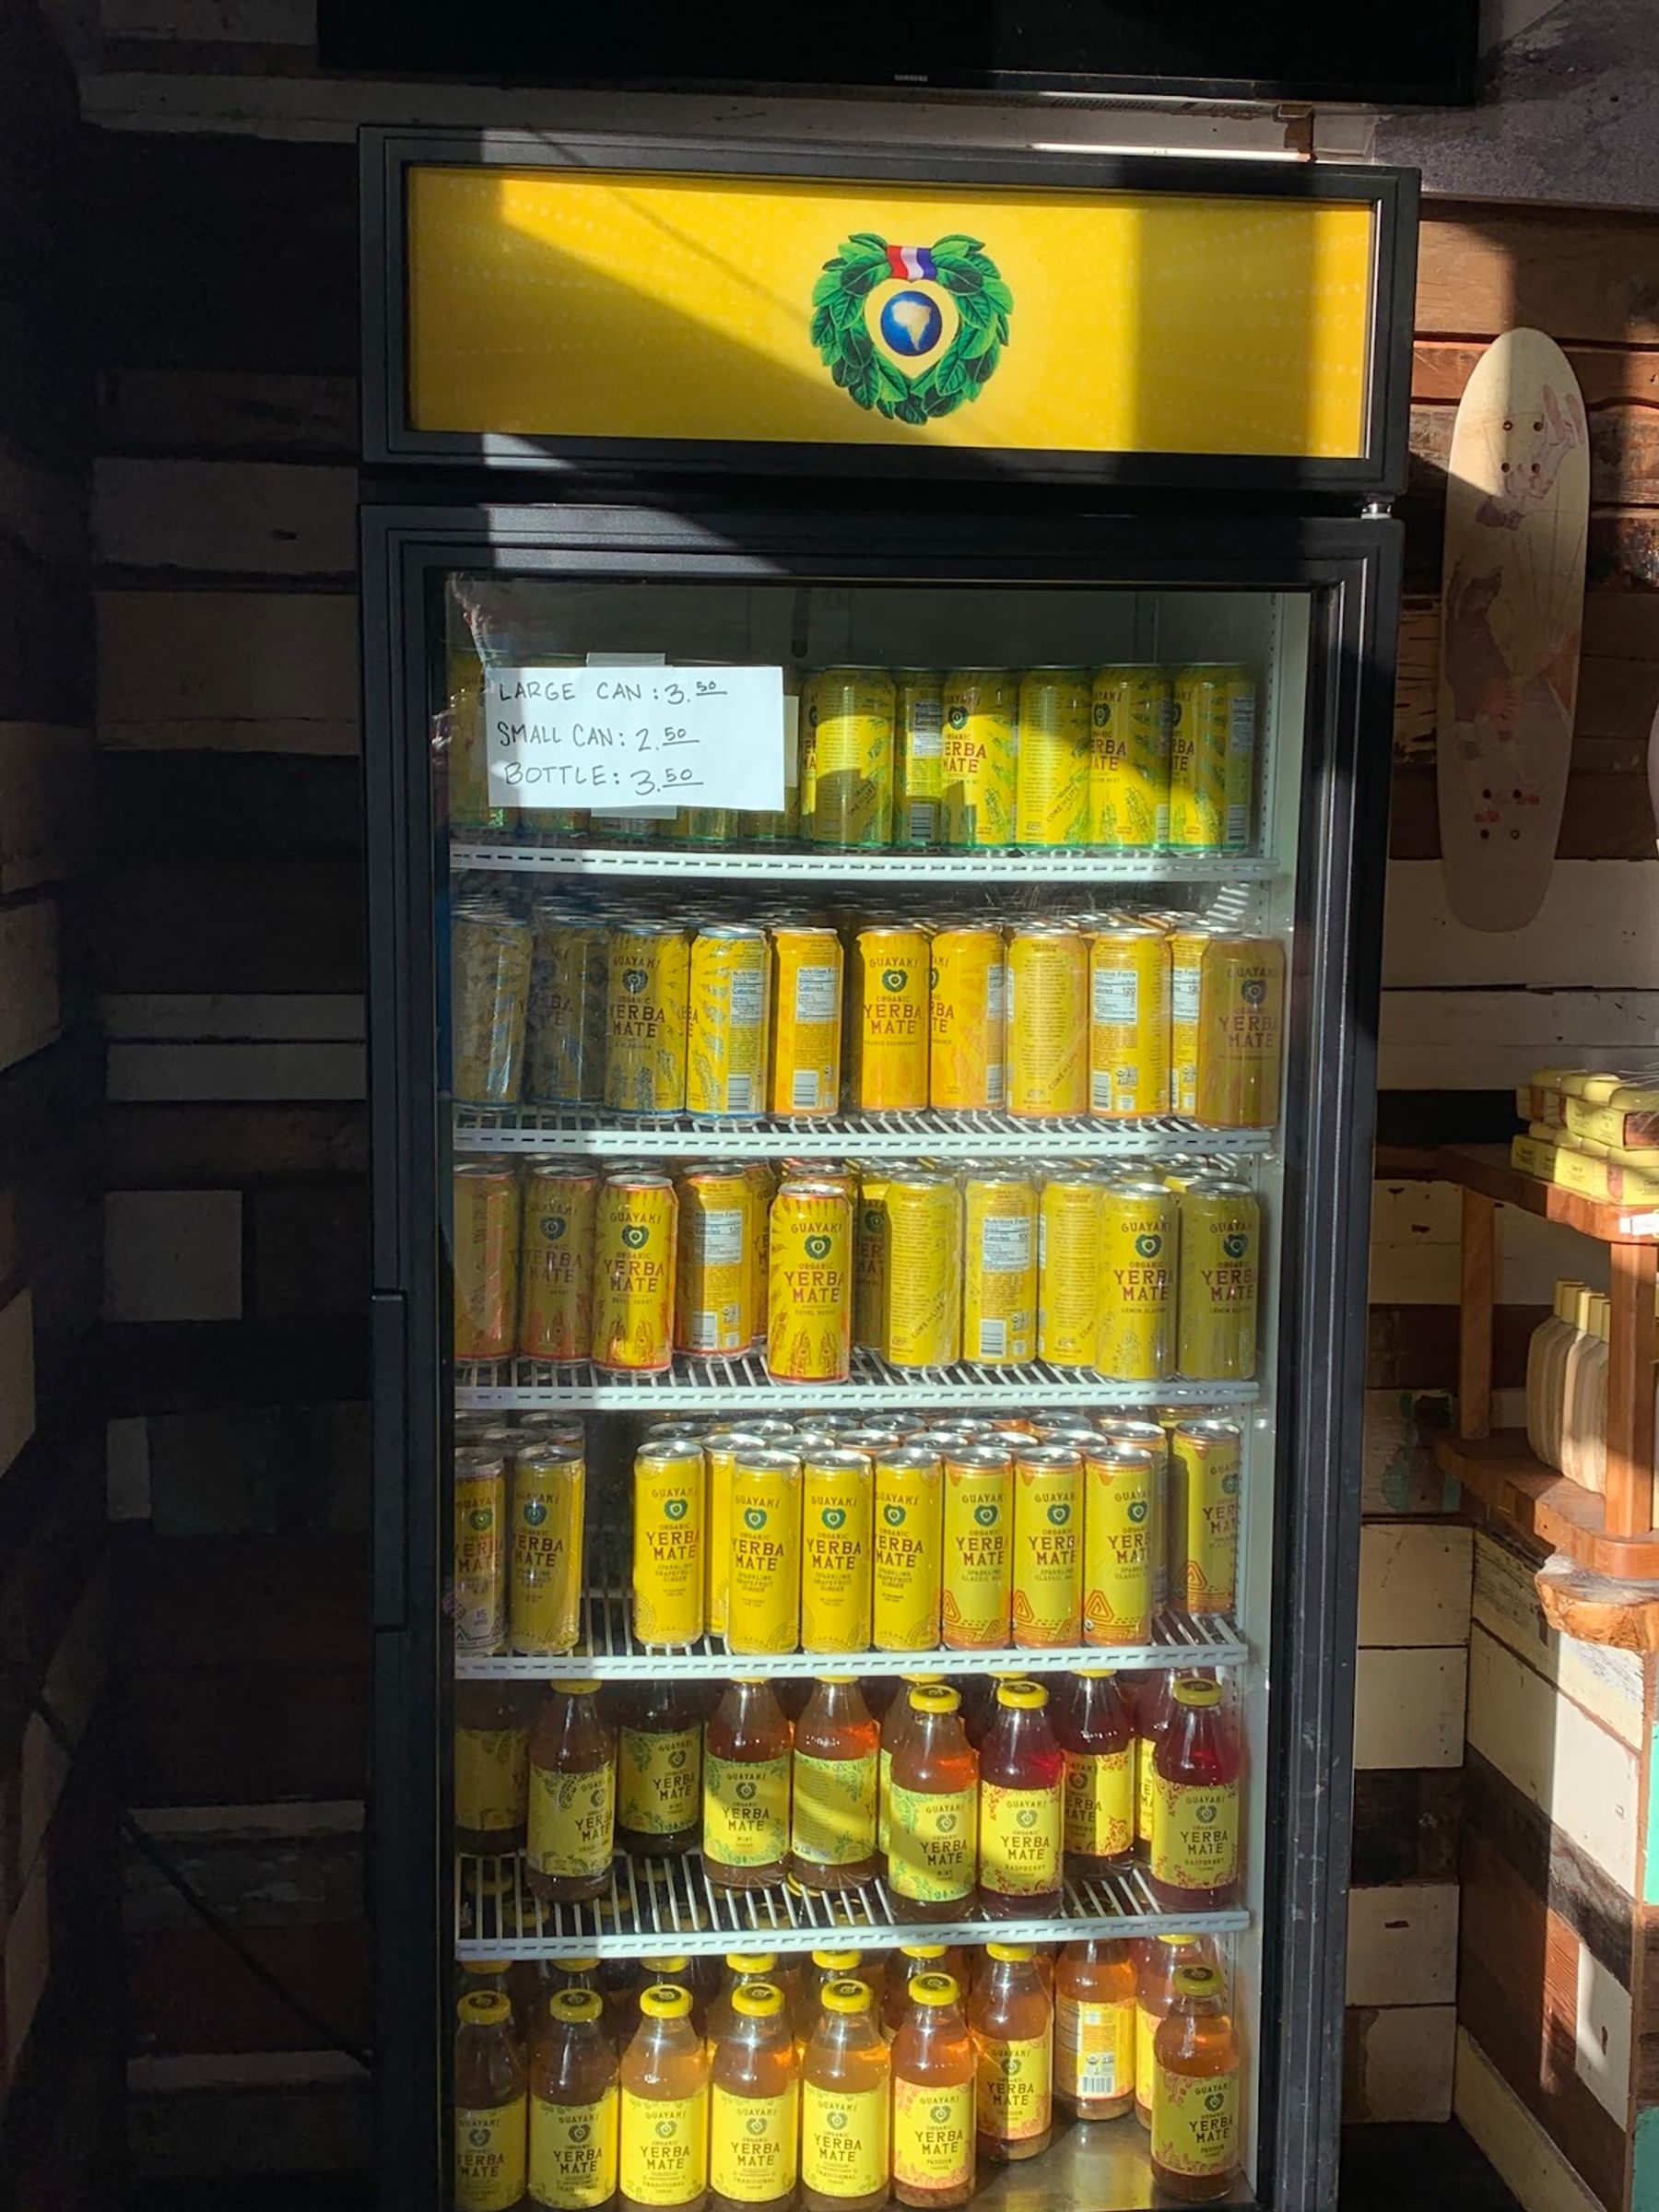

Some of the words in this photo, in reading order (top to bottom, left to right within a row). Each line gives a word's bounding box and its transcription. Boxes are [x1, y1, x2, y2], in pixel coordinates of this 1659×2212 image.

[500, 681, 575, 701] LARGE
[497, 722, 561, 747] SMALL
[572, 724, 625, 747] CAN:
[945, 741, 987, 758] ERBA
[504, 762, 619, 785] BOTTLE:
[869, 957, 918, 968] GUAYAKI
[863, 1004, 922, 1018] YERBA
[613, 1020, 657, 1038] MATE
[871, 1020, 916, 1034] MATE
[1230, 1033, 1273, 1048] MATE
[611, 1213, 661, 1224] GUAYAKI
[791, 1223, 841, 1233] GUAYAKI
[604, 1260, 664, 1276] YERBA
[611, 1277, 658, 1292] MATE
[784, 1271, 844, 1287] YERBA
[793, 1288, 840, 1303] MATE
[1124, 1287, 1170, 1301] MATE
[1211, 1287, 1253, 1301] MATE
[811, 1496, 857, 1507] GUAYAKI
[732, 1538, 784, 1556] YERBA
[806, 1538, 861, 1555] YERBA
[876, 1534, 924, 1553] ERBA
[957, 1536, 1006, 1550] YERB
[1029, 1535, 1076, 1550] YERB
[654, 1545, 696, 1560] MATE
[877, 1550, 916, 1567] MATE
[964, 1551, 1005, 1566] MATE
[1037, 1550, 1077, 1565] MATE
[735, 1555, 778, 1571] MATE
[812, 1556, 855, 1570] MATE
[660, 1785, 691, 1801] MATE
[1186, 1796, 1224, 1805] GUAYAKI
[723, 1807, 770, 1819] YERBA
[926, 1805, 964, 1813] GUAYAKI
[728, 1821, 764, 1831] MATE
[1001, 1836, 1050, 1848] YERBA
[1181, 1830, 1228, 1842] YERBA
[920, 1840, 967, 1853] YERBA
[1188, 1842, 1223, 1854] MATE
[927, 1853, 963, 1865] MATE
[1007, 1849, 1044, 1860] MATE
[987, 2081, 1034, 2094] YERBA
[818, 2100, 858, 2112] GUAYAKI
[920, 2096, 959, 2105] GUAYAKI
[994, 2095, 1029, 2105] MATE
[559, 2114, 599, 2124] GUAYAKI
[737, 2108, 776, 2116] GUAYAKI
[814, 2134, 863, 2151] YERBA
[915, 2129, 963, 2143] YERBA
[1196, 2128, 1230, 2143] MATE
[554, 2148, 602, 2162] YERBA
[640, 2146, 690, 2158] YERBA
[731, 2142, 780, 2154] YERBA
[819, 2148, 856, 2162] MATE
[922, 2142, 959, 2155] MATE
[560, 2161, 597, 2174] MATE
[647, 2158, 685, 2170] MATE
[737, 2155, 774, 2166] MATE
[462, 2167, 499, 2178] MATE
